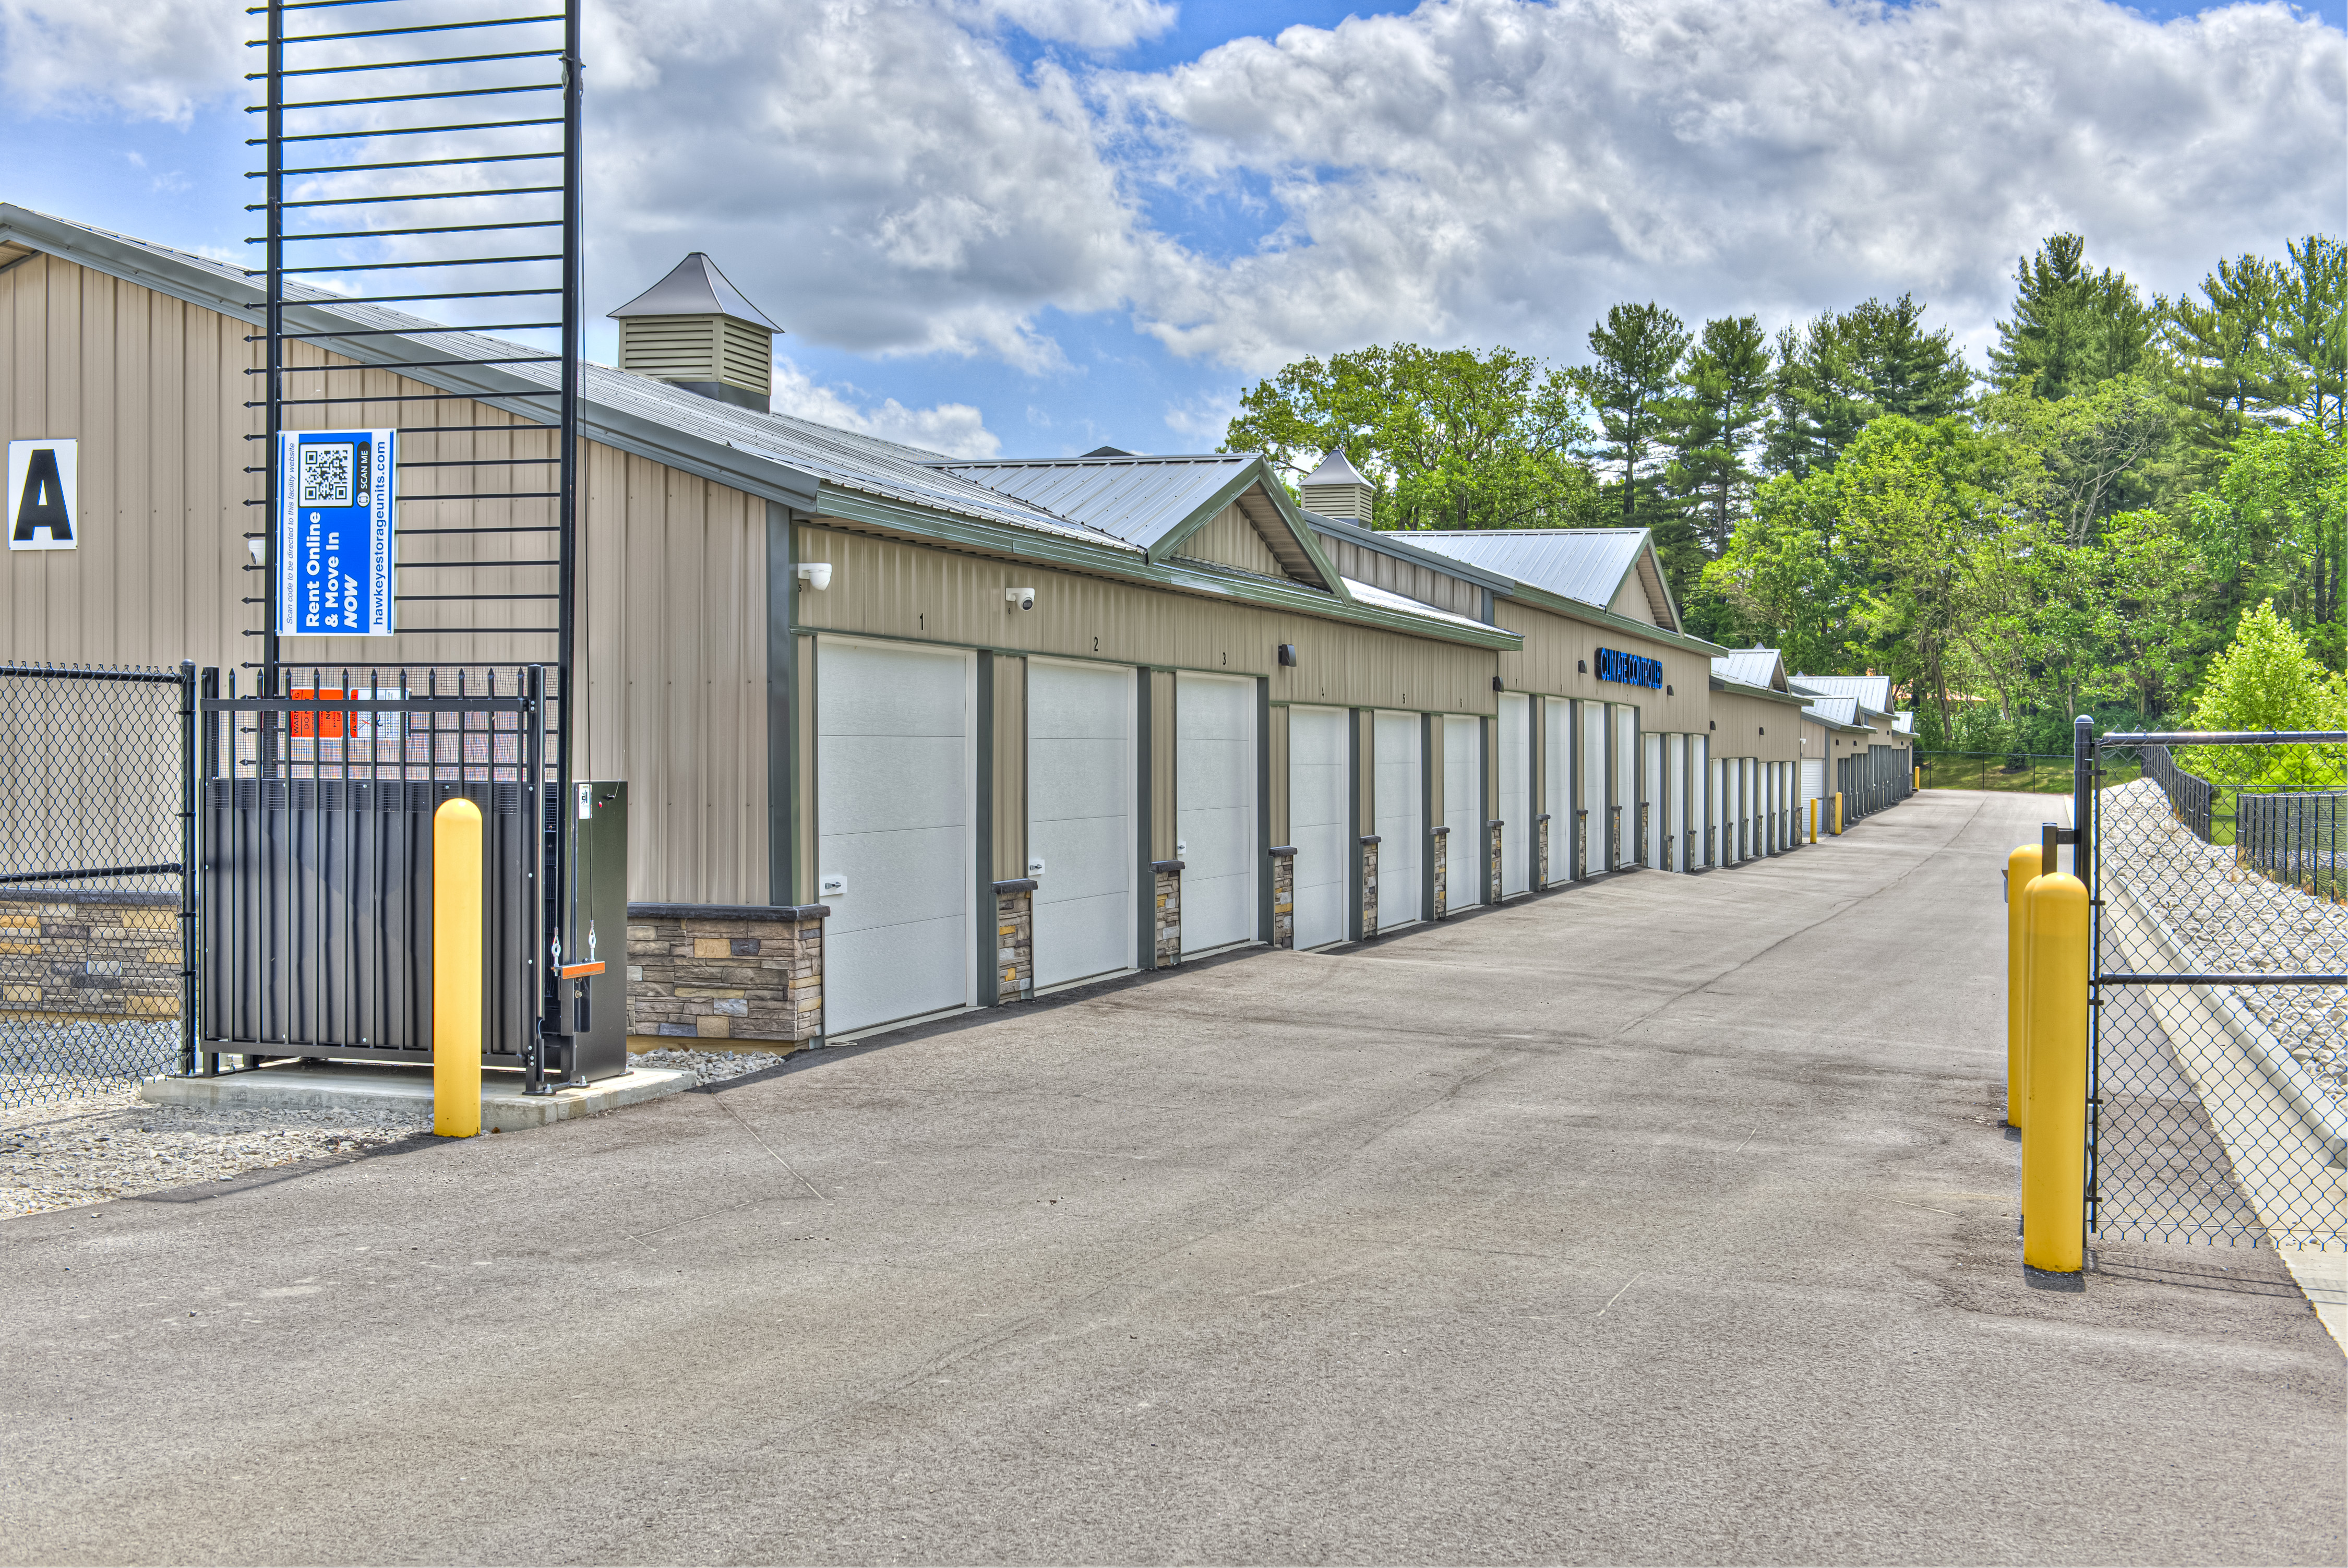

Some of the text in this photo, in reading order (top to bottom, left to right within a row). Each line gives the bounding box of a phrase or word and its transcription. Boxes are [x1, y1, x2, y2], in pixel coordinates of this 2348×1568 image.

[361, 450, 368, 463] ME
[13, 449, 74, 541] A
[287, 474, 296, 499] facility
[373, 441, 387, 625] hawkeyestorageunits.com
[287, 561, 293, 571] be
[306, 511, 321, 627] Rent Online
[325, 532, 339, 627] & Move In
[798, 584, 802, 592] 5
[344, 573, 358, 628] NOW
[919, 613, 924, 631] 1
[1094, 636, 1098, 652] 2
[1223, 652, 1226, 666] 3
[1600, 647, 1663, 690] CLIMATE CONTROLLED
[1321, 687, 1324, 699] 4
[1403, 693, 1406, 704] 5
